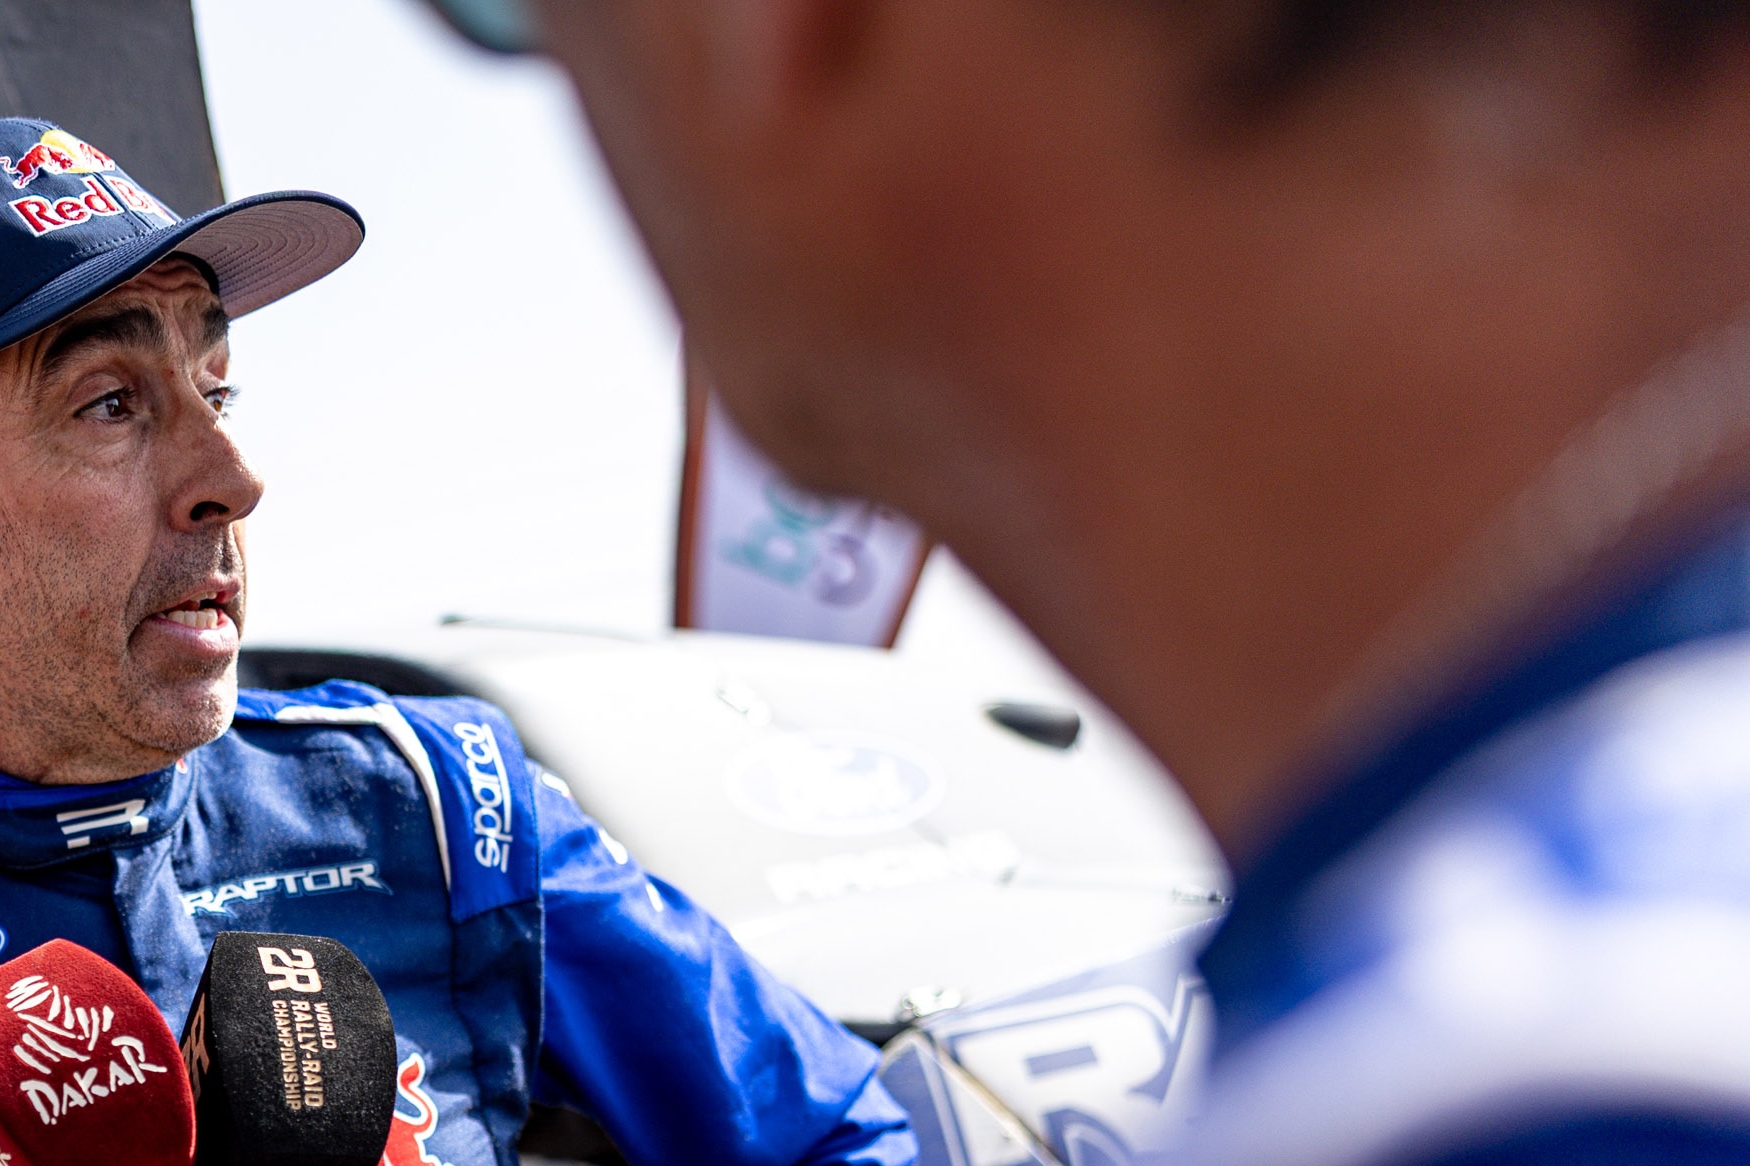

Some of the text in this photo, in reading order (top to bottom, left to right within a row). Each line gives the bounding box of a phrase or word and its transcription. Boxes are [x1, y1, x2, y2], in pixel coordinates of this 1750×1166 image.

[8, 175, 124, 238] Red
[453, 721, 513, 871] sparco
[178, 861, 393, 917] RAPTOR
[272, 1000, 302, 1111] CHAMPIONSHIP
[291, 1000, 325, 1108] RALLY-RAID
[314, 1002, 338, 1050] WORLD
[20, 1035, 168, 1126] DAKAR
